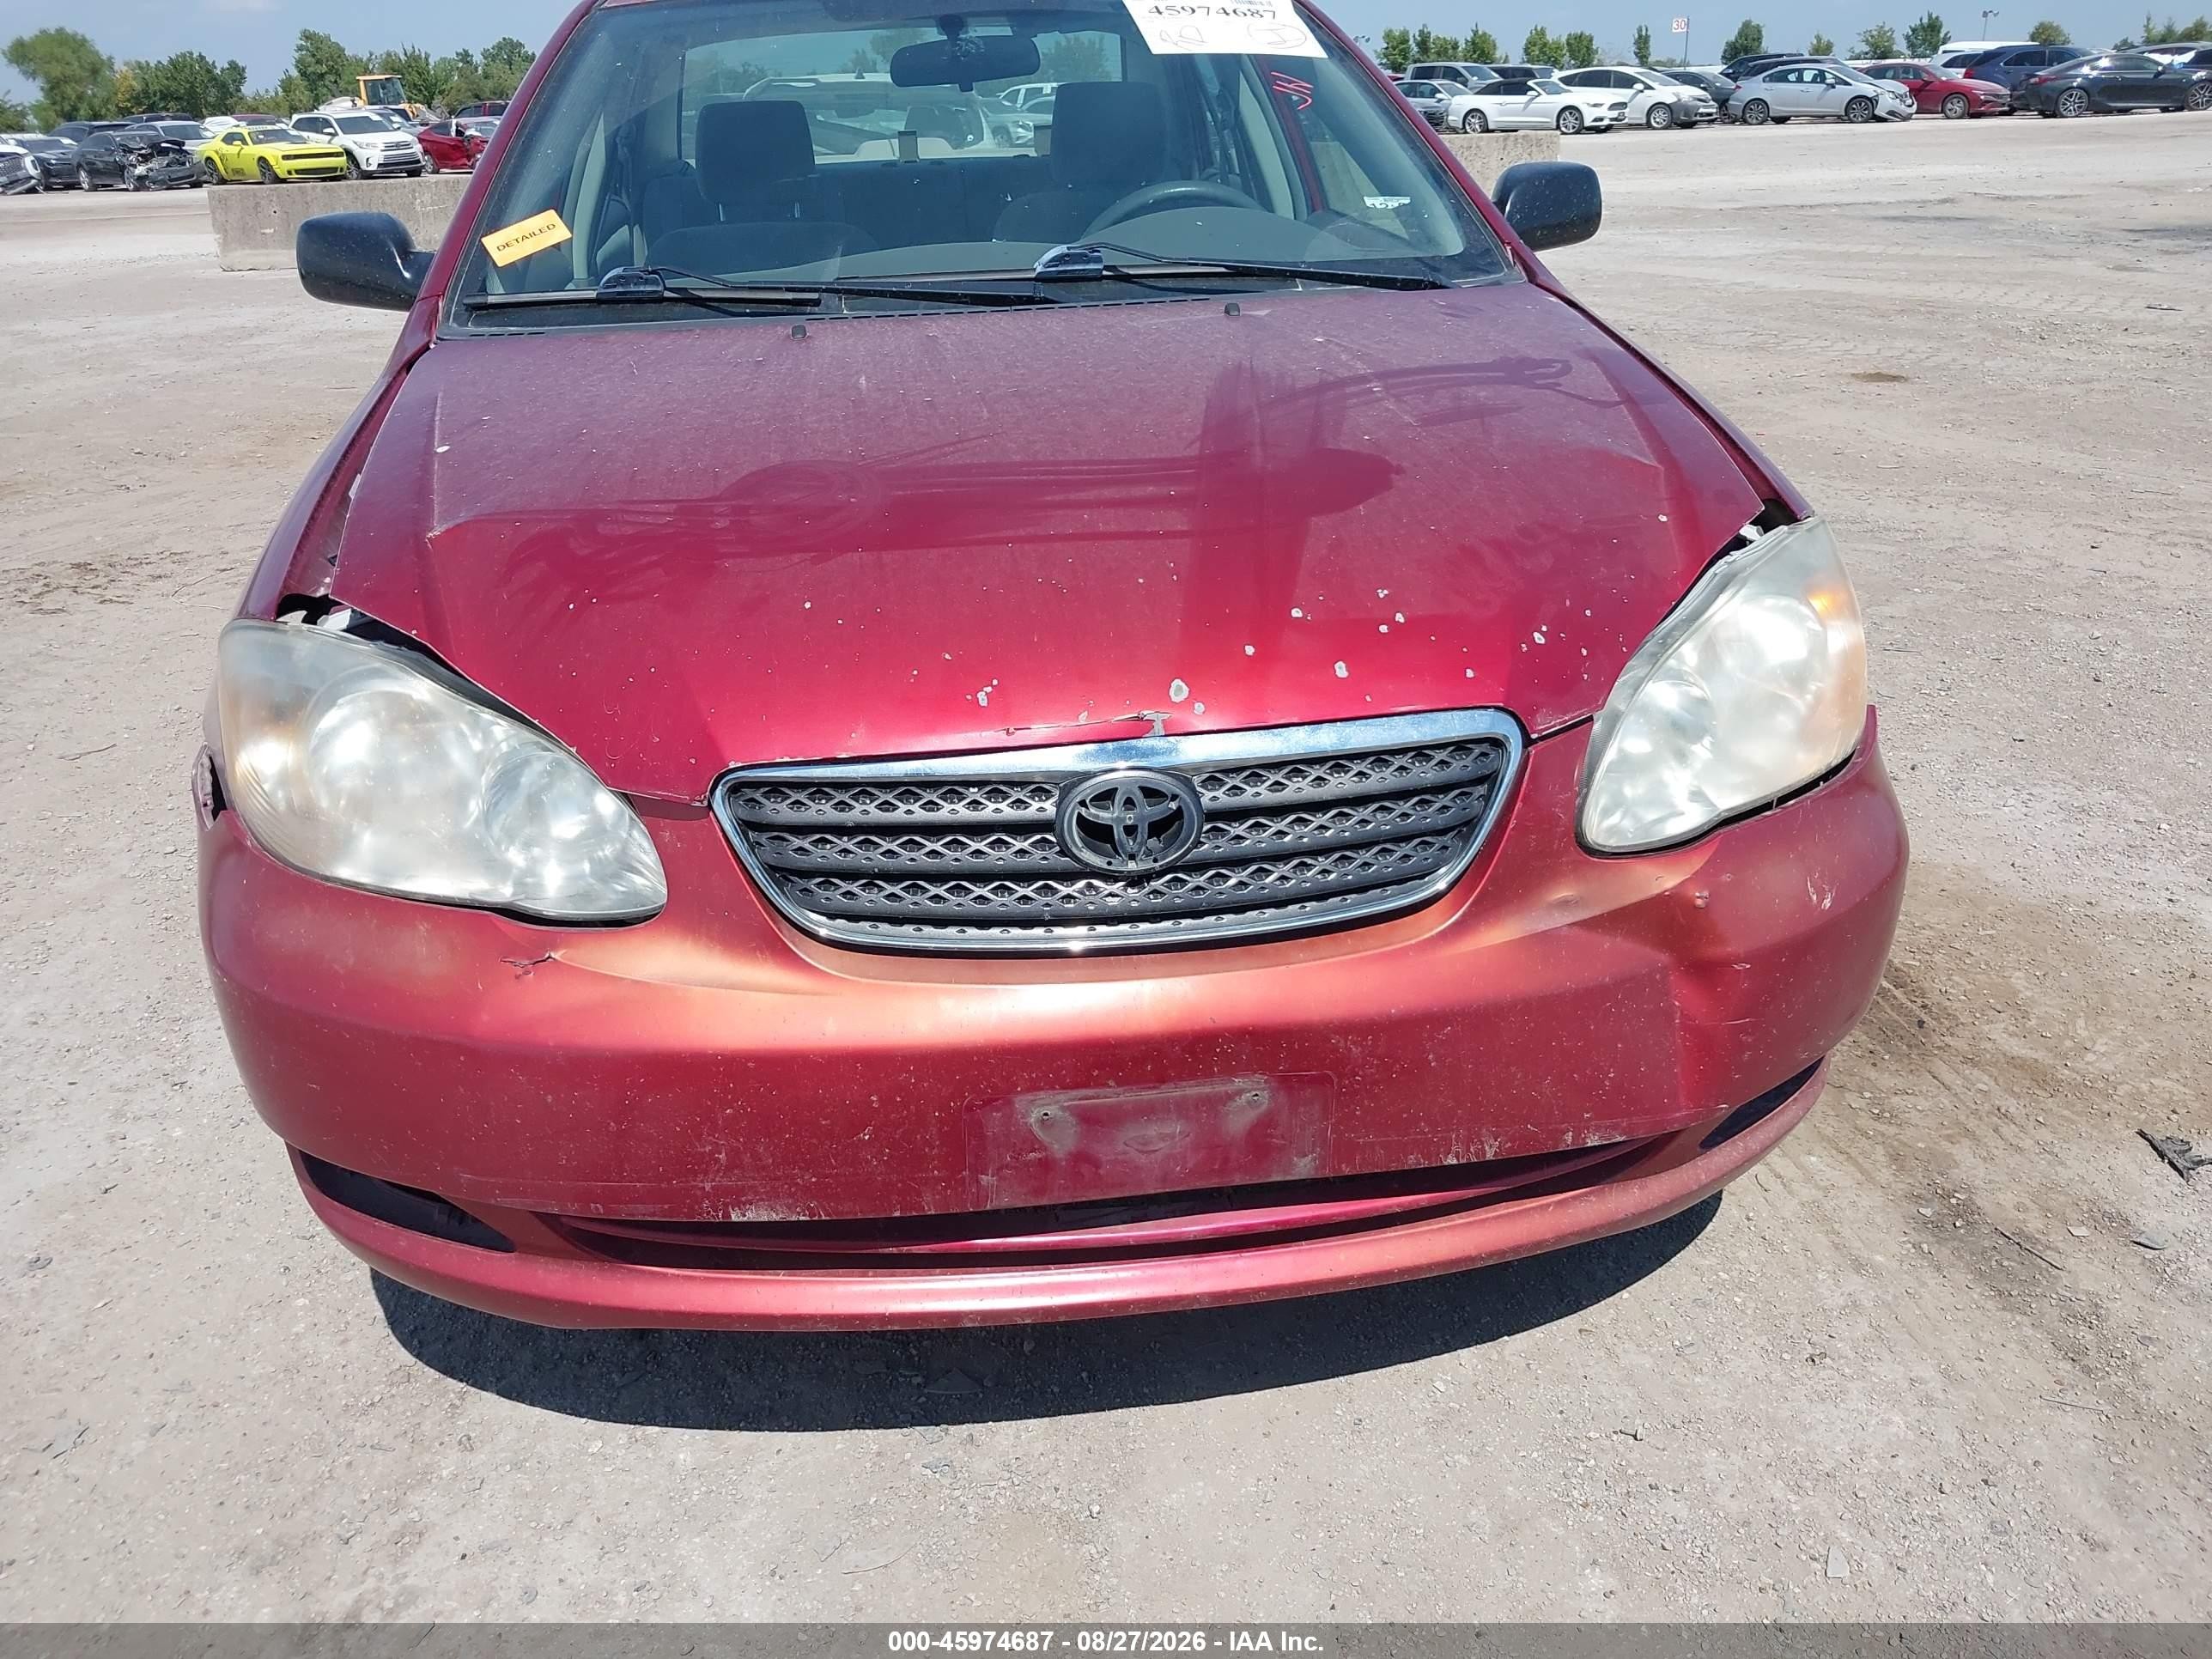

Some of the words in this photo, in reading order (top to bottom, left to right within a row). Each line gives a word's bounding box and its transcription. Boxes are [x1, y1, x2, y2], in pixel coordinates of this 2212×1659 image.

[1148, 5, 1276, 20] 45974687
[1674, 19, 1686, 30] 30
[496, 223, 556, 252] DETAILED
